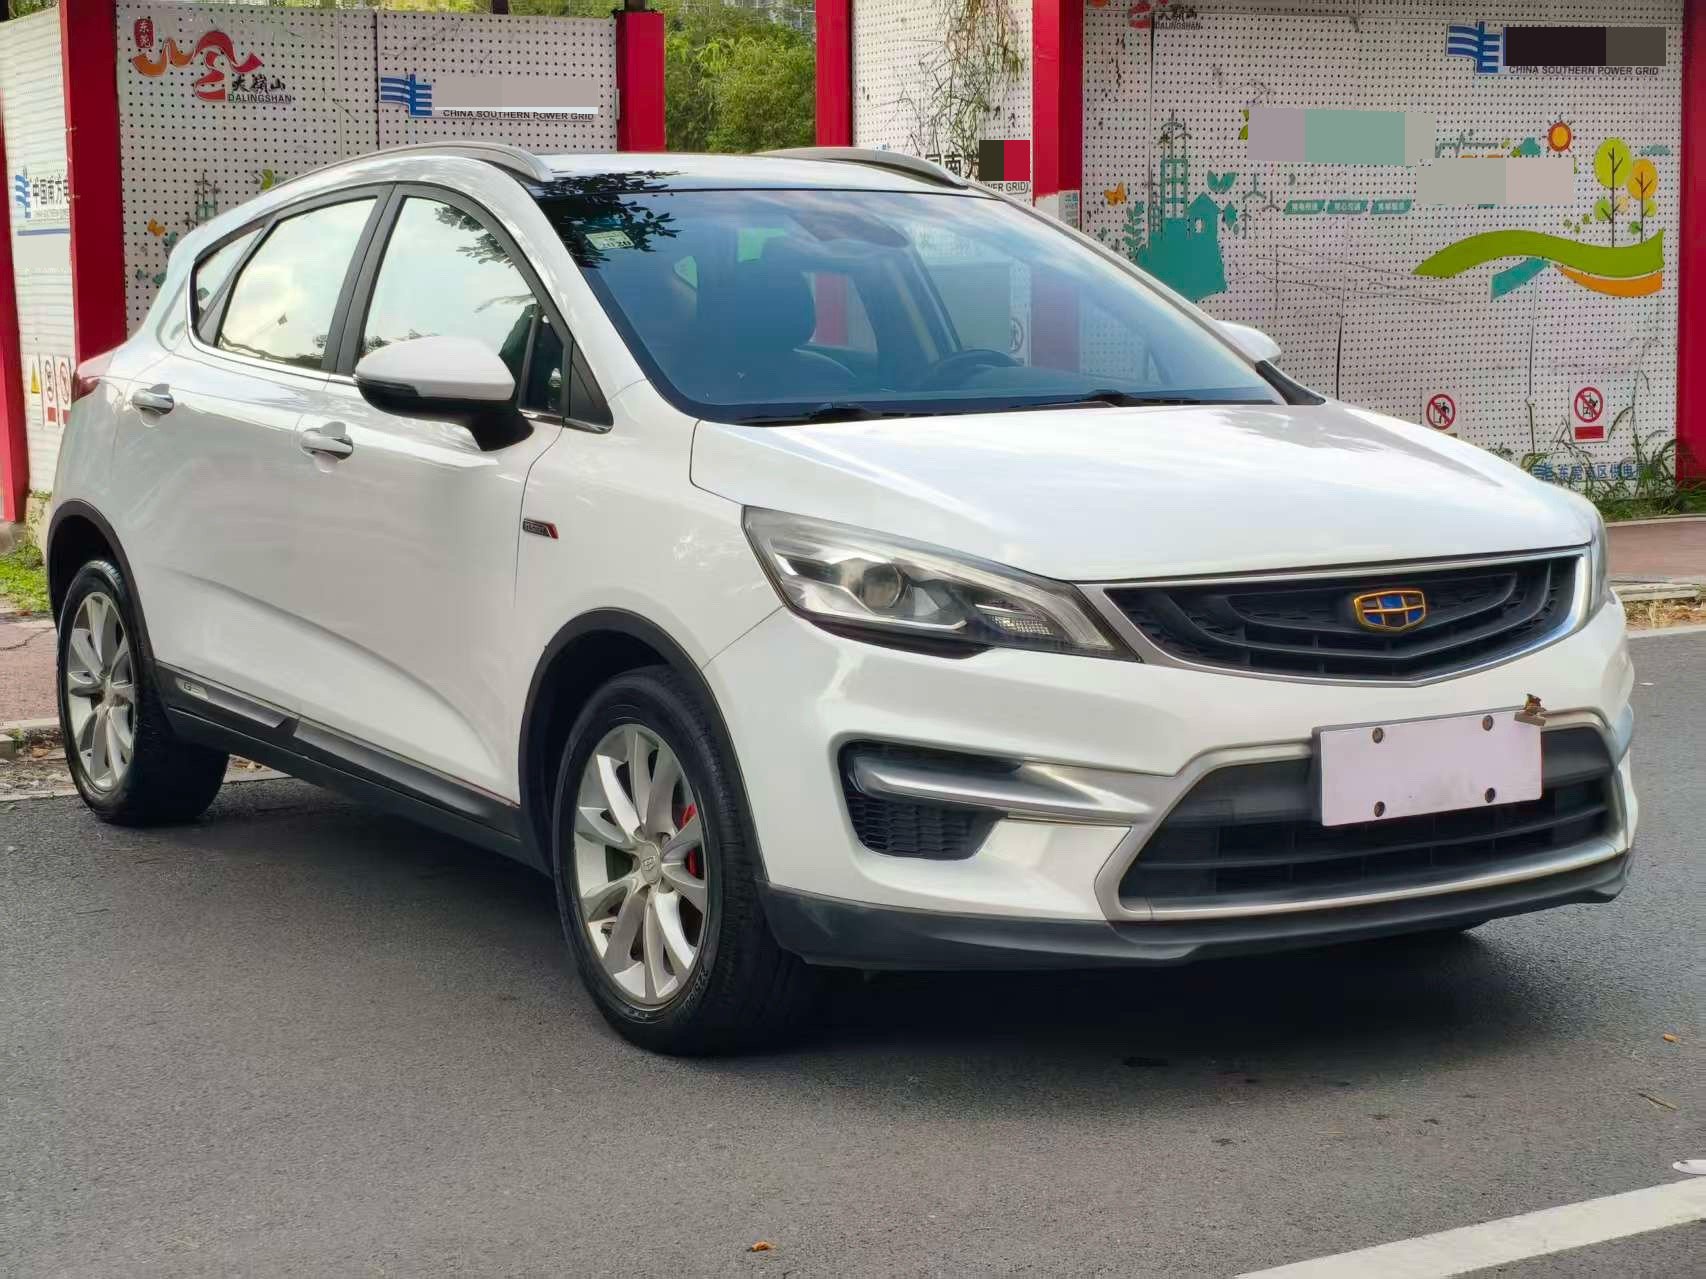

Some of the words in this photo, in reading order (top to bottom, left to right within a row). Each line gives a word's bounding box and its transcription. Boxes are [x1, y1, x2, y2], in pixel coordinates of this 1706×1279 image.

[1509, 66, 1539, 75] CHINA
[1542, 66, 1595, 75] SOUTHERN
[1598, 66, 1632, 75] POWER
[1635, 67, 1659, 76] GRID
[228, 94, 292, 104] DALINGSHAN
[443, 109, 474, 118] CHINA
[476, 110, 530, 119] SOUTHERN
[533, 111, 569, 120] POWER
[570, 112, 594, 121] GRID
